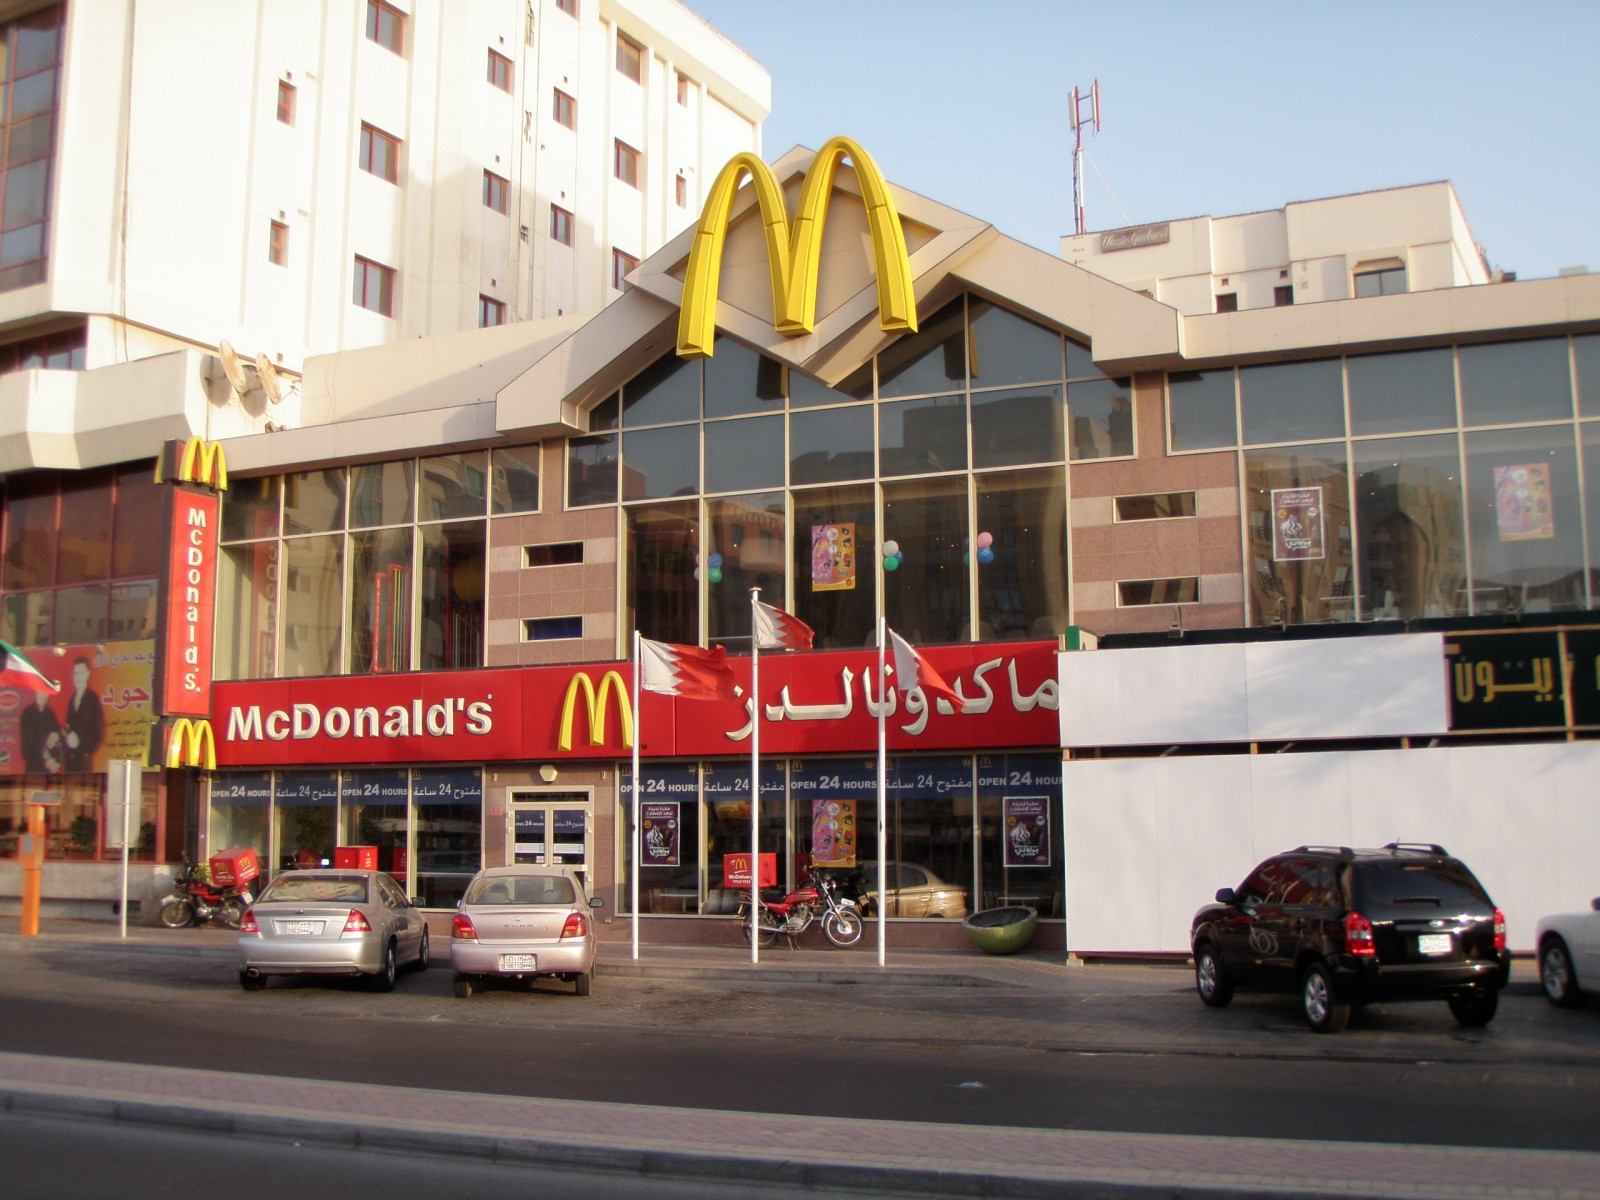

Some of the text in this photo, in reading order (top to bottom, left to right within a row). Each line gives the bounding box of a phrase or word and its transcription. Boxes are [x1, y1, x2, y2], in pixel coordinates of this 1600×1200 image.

[184, 506, 208, 694] McDonald's
[226, 696, 494, 742] McDonald's
[620, 779, 699, 793] OPN 24 HOURS
[704, 778, 785, 794] مفتو 24 ساعة
[790, 775, 878, 790] OPEN 24 HOURS
[885, 774, 972, 793] مفتوح 24 ساعة
[978, 777, 1007, 786] OPEN
[1009, 771, 1032, 786] 24
[211, 786, 271, 798] OPEN 24 HOURS
[275, 785, 337, 800] مفتوح 24 ساعة
[342, 784, 409, 797] OPEN 24 HOURS
[413, 783, 481, 800] مفتوح 24 ساعة
